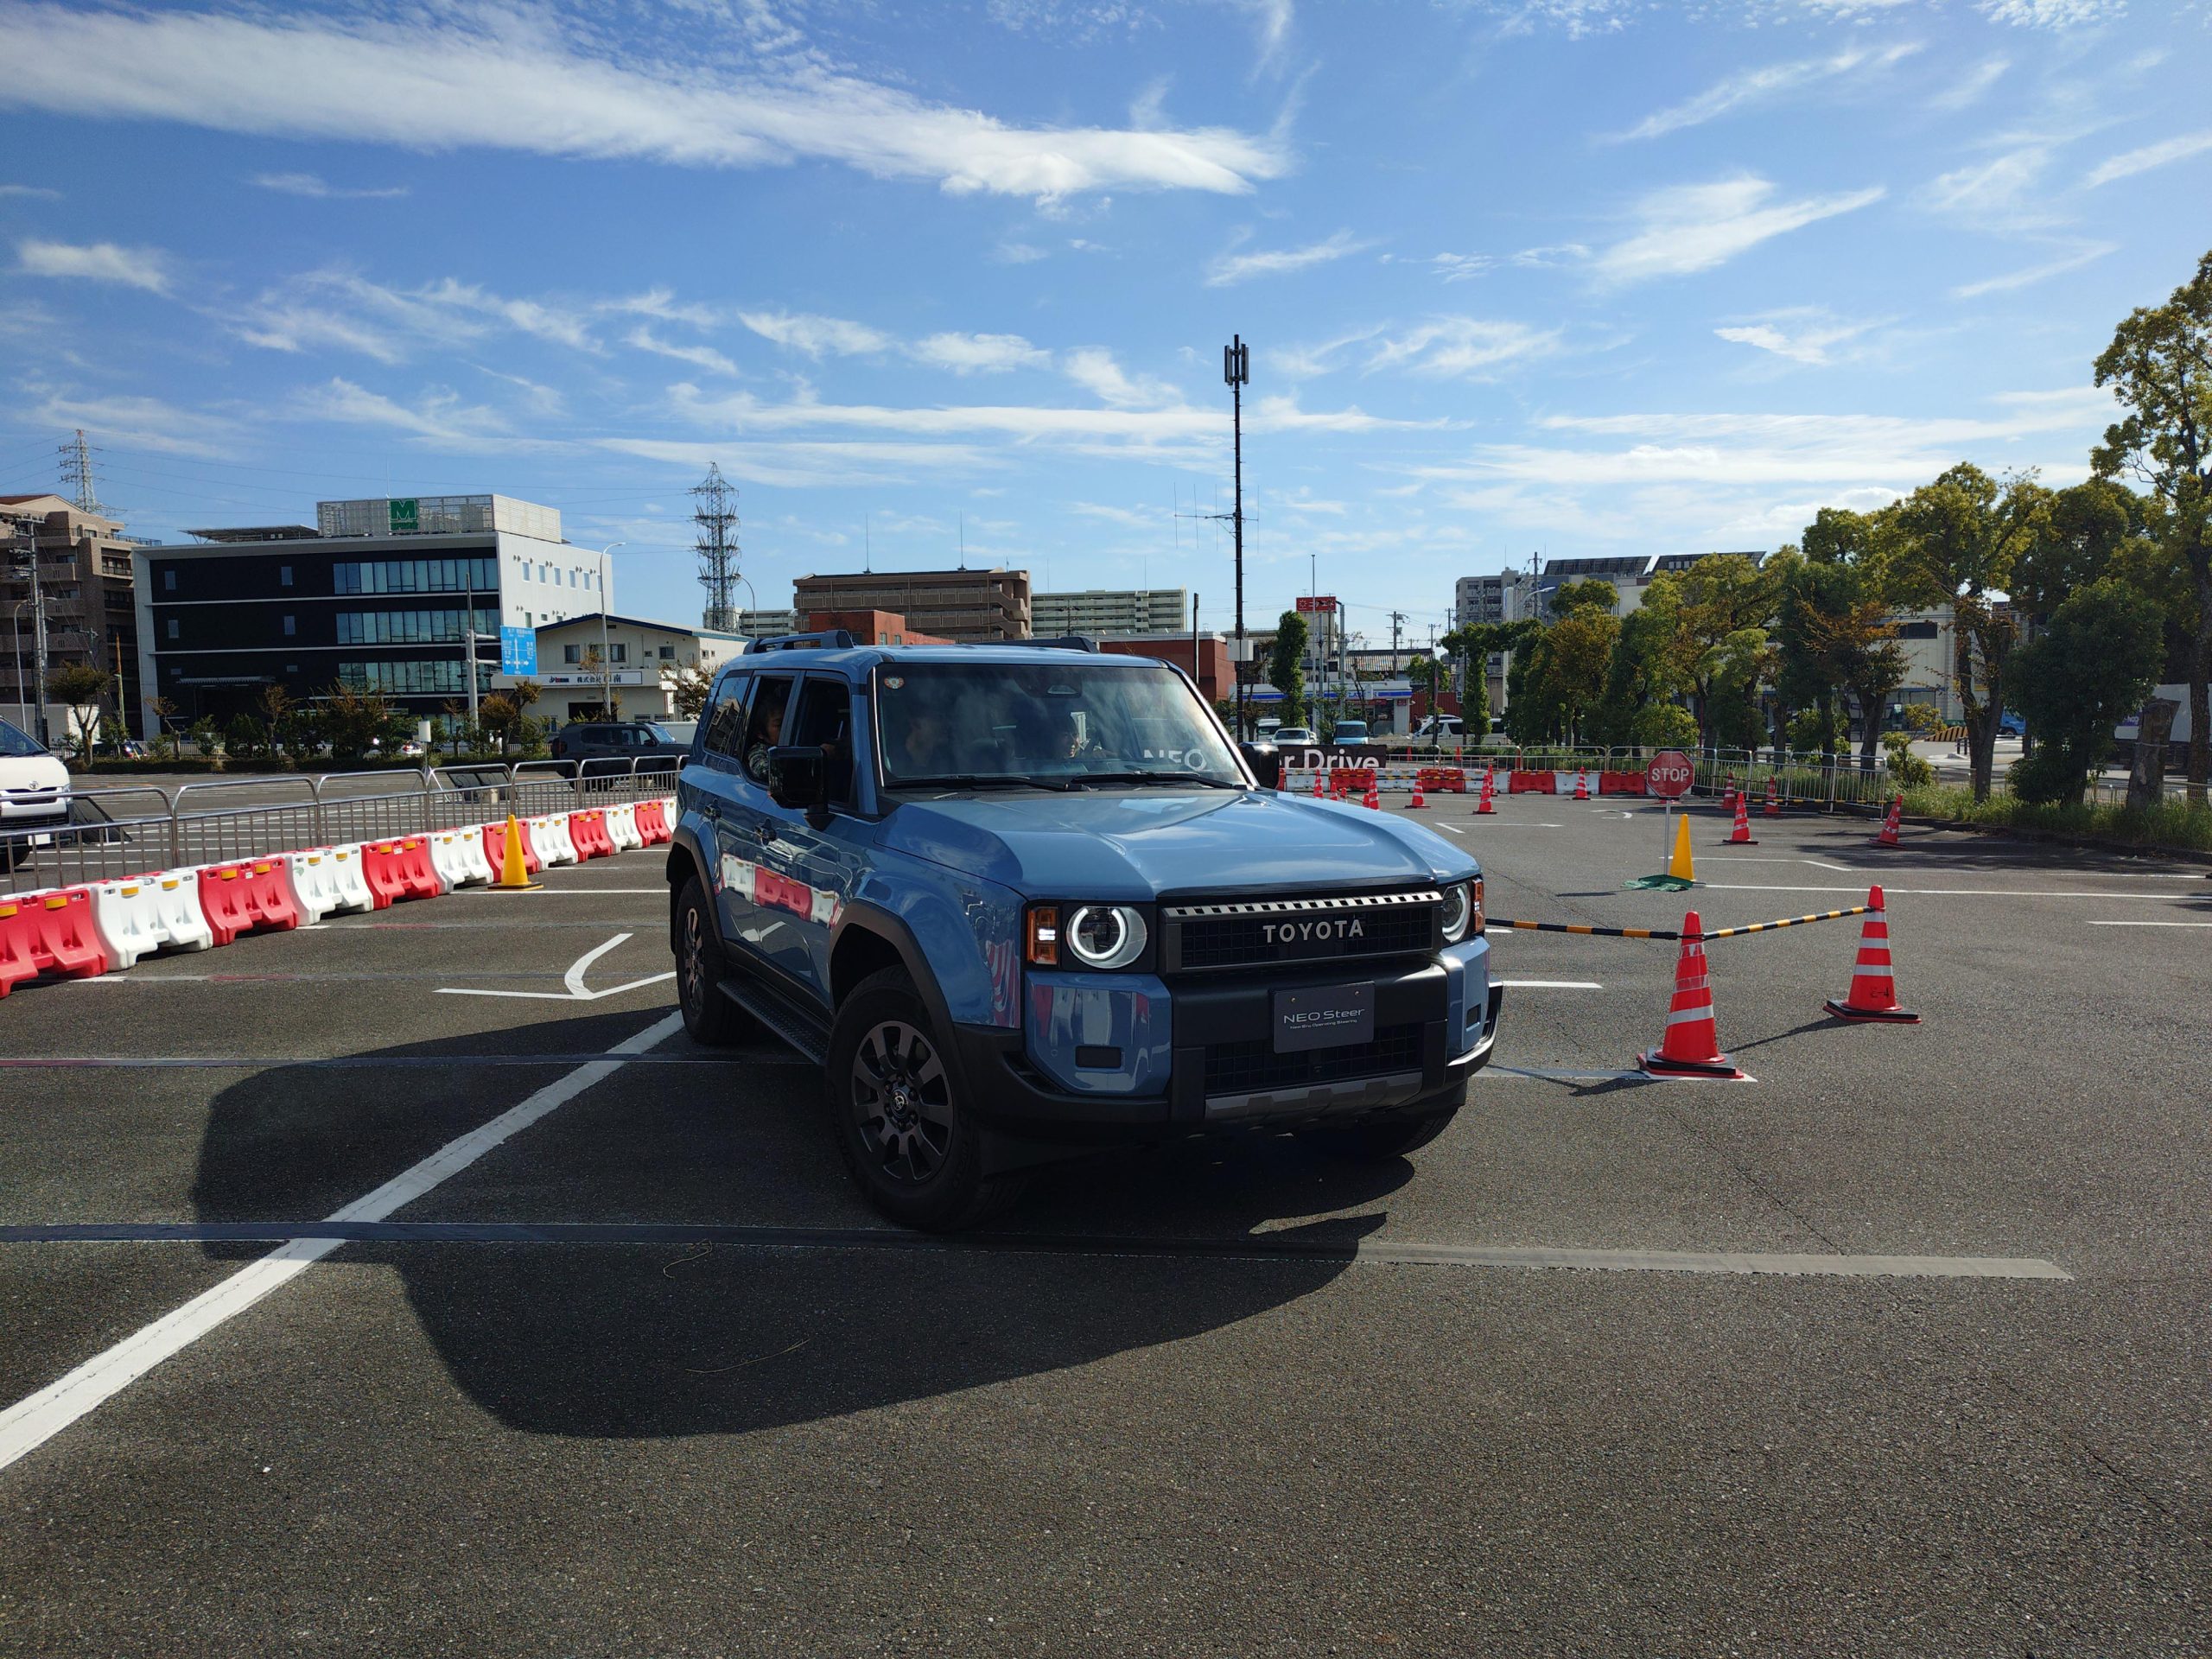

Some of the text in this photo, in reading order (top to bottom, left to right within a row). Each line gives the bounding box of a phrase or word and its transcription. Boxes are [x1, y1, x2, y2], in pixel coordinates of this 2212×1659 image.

[1304, 748, 1380, 770] Drive
[1651, 767, 1689, 782] STOP
[1262, 918, 1364, 944] TOYOTA
[1283, 1008, 1365, 1024] NEO Steer
